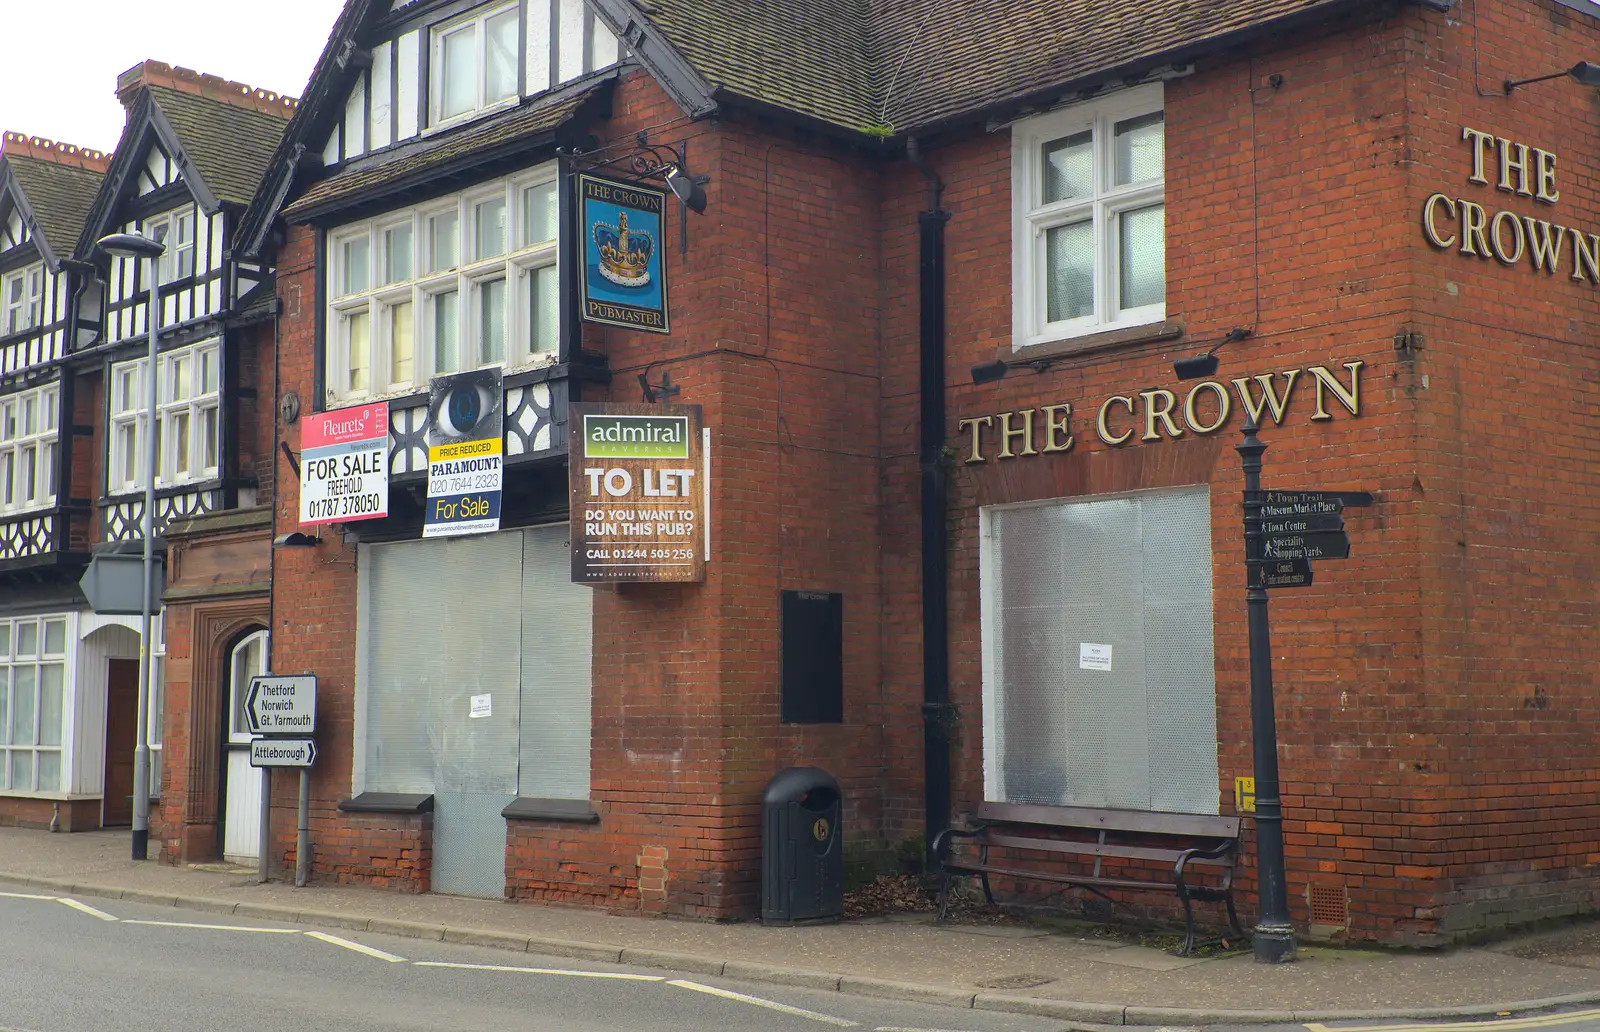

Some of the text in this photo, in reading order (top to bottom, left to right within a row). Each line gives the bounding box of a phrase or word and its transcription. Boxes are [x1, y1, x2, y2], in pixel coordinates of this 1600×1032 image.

[1461, 126, 1560, 204] THE
[586, 183, 660, 210] THE CROWN
[1423, 192, 1600, 286] CROWN
[589, 301, 662, 326] PUBMASTER
[958, 361, 1364, 464] THE CROWN
[323, 418, 365, 437] Fleurets
[592, 422, 680, 443] admiral
[439, 442, 492, 458] PRICE REDUCED
[600, 445, 672, 453] TAVERNS
[307, 452, 381, 481] FOR SALE
[431, 457, 500, 477] PARAMOUNT
[328, 477, 362, 496] FREEHOLD
[430, 473, 499, 493] 020 7644 2323
[584, 468, 695, 498] TO LET
[309, 493, 380, 518] 01787 378050
[1276, 493, 1299, 503] Town
[435, 496, 490, 520] For Sale
[585, 510, 695, 522] DO YOU WANT TO
[1266, 501, 1336, 516] Museum Market Place
[585, 523, 693, 537] RUN THIS PUB?
[1267, 521, 1307, 533] Town Centre
[1272, 536, 1304, 548] Speciality
[586, 549, 693, 561] CALL 01244 505 256
[1272, 546, 1323, 560] Shopping Yards
[262, 684, 295, 696] Thetford
[261, 699, 294, 711] Norwich
[261, 714, 311, 726] Gt. Yarmouth
[254, 747, 305, 761] Attleborough
